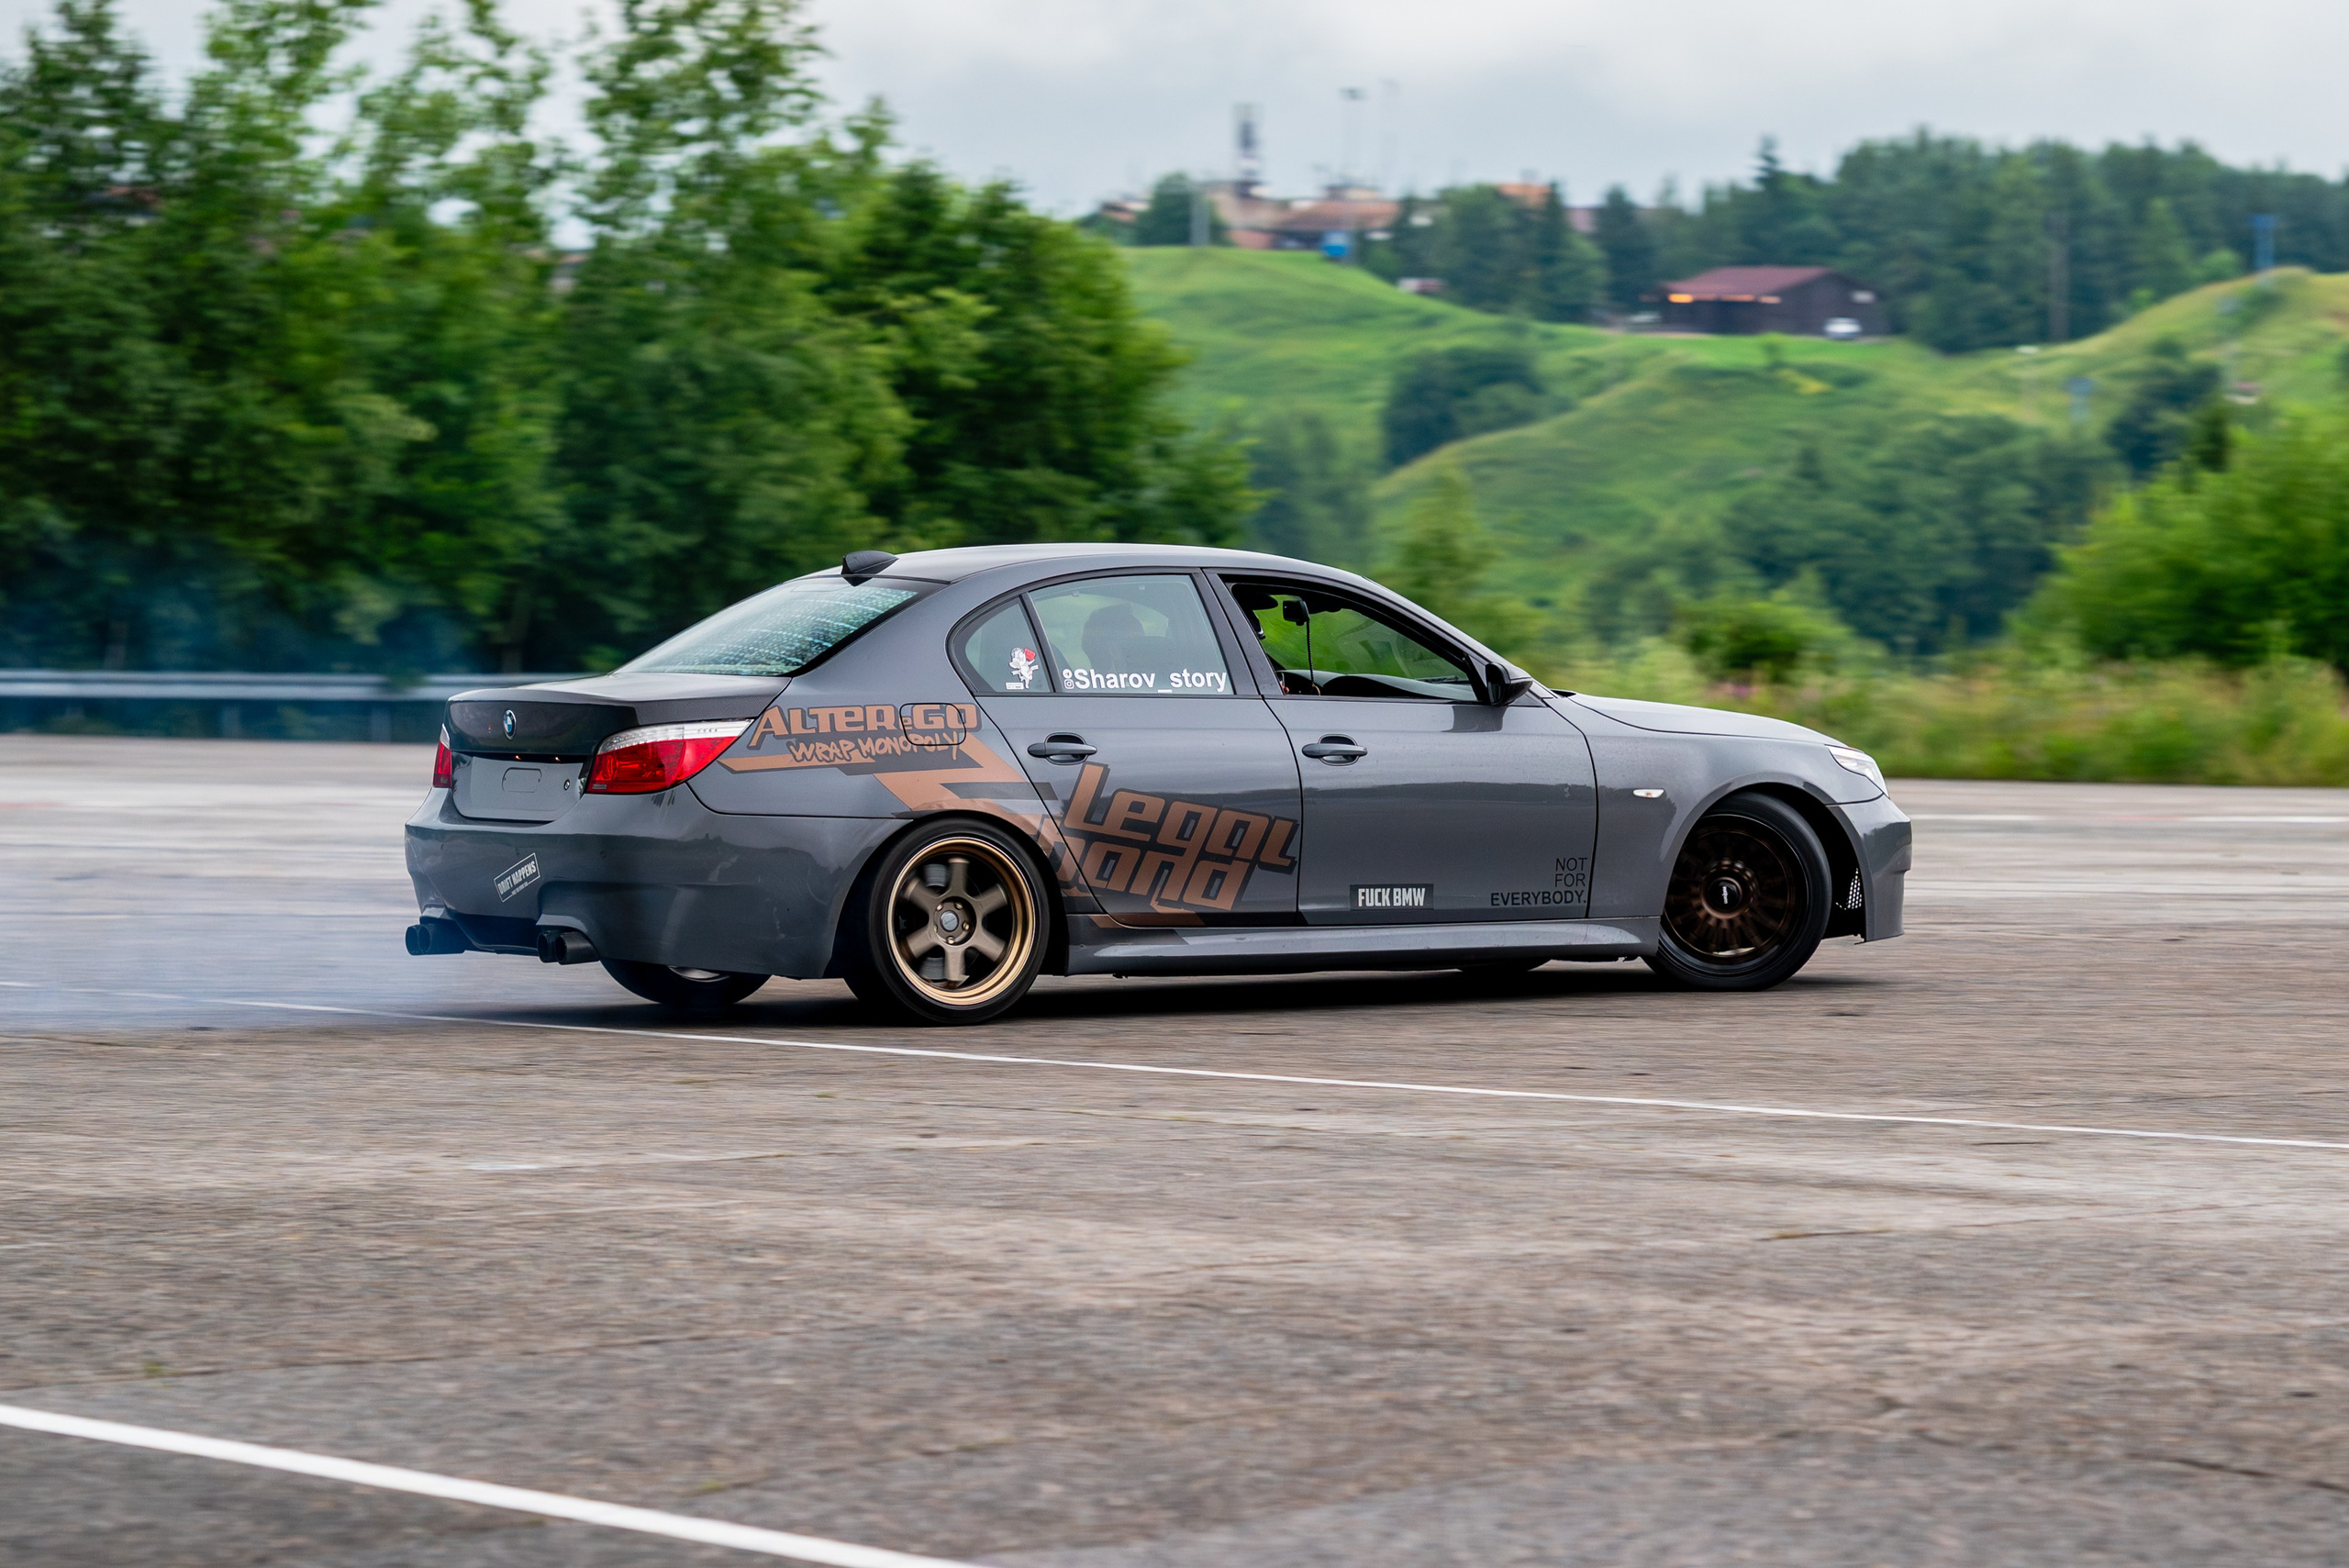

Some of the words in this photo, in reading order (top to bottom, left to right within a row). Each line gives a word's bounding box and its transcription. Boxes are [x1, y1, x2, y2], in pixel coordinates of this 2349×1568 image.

[1074, 668, 1227, 693] Sharov_story
[789, 739, 856, 762] WRAP
[858, 731, 959, 761] MONOPOLY
[1555, 857, 1587, 872] NOT
[1554, 873, 1586, 887] FOR
[1358, 888, 1390, 907] FUCK
[1393, 887, 1426, 906] BMW
[1490, 890, 1587, 906] EVERYBODY.
